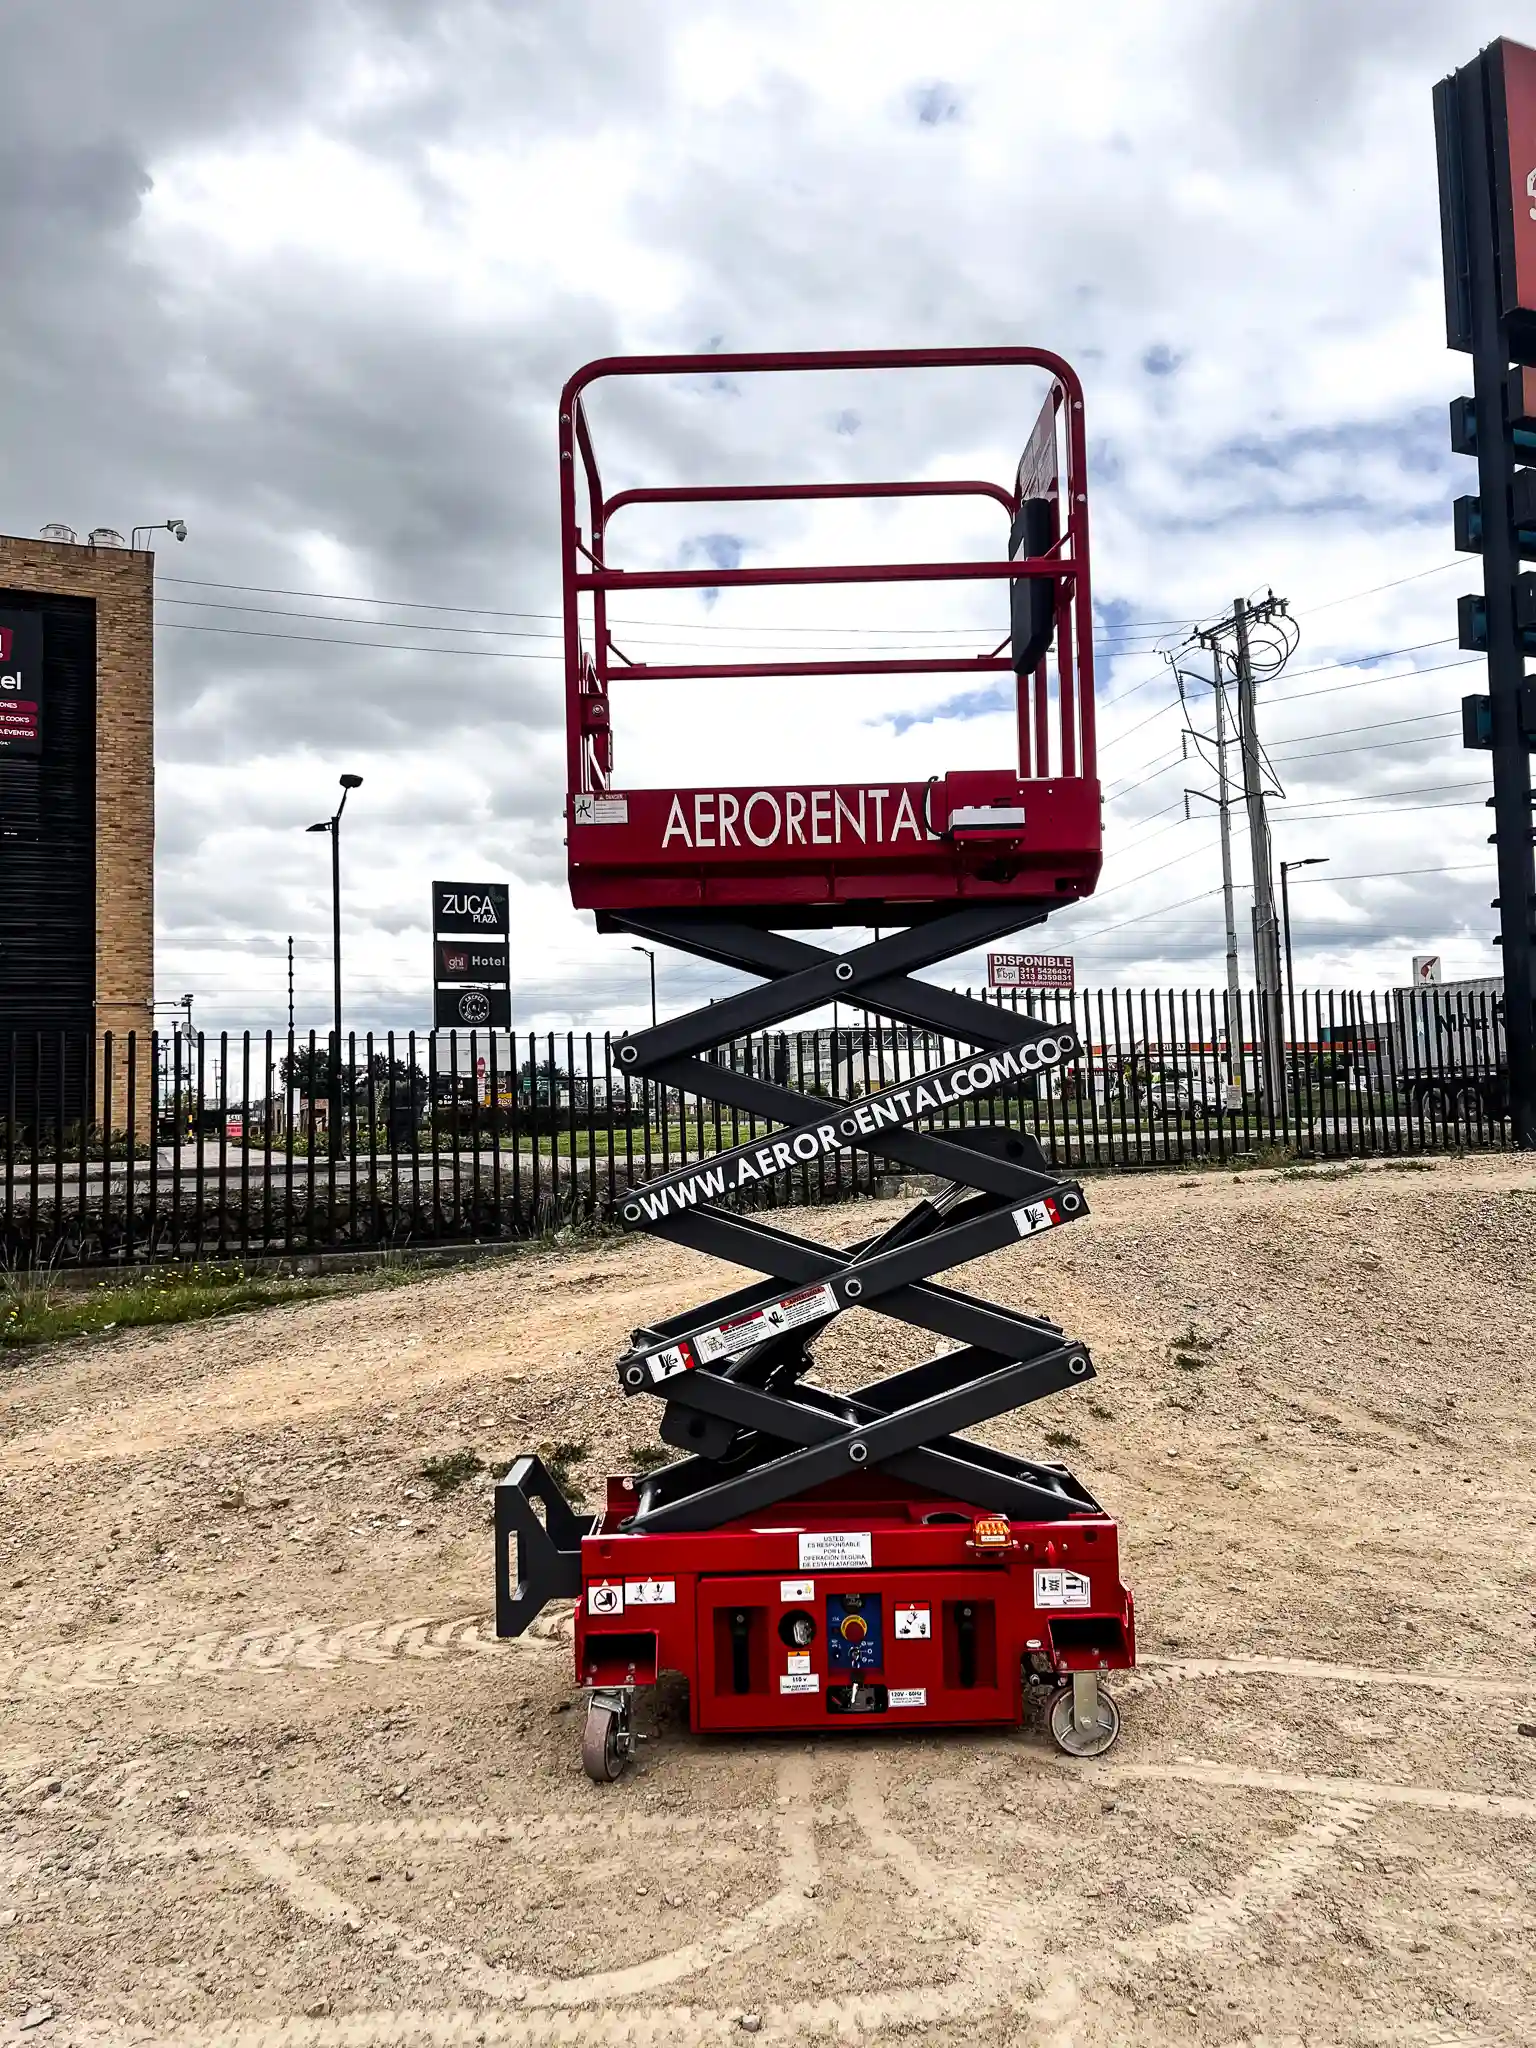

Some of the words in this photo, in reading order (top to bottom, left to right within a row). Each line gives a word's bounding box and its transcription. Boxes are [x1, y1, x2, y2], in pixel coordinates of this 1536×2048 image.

[442, 894, 494, 914] ZUCA
[473, 914, 498, 924] PLAZA
[472, 956, 506, 966] Hotel
[994, 956, 1072, 966] DISPONIBLE
